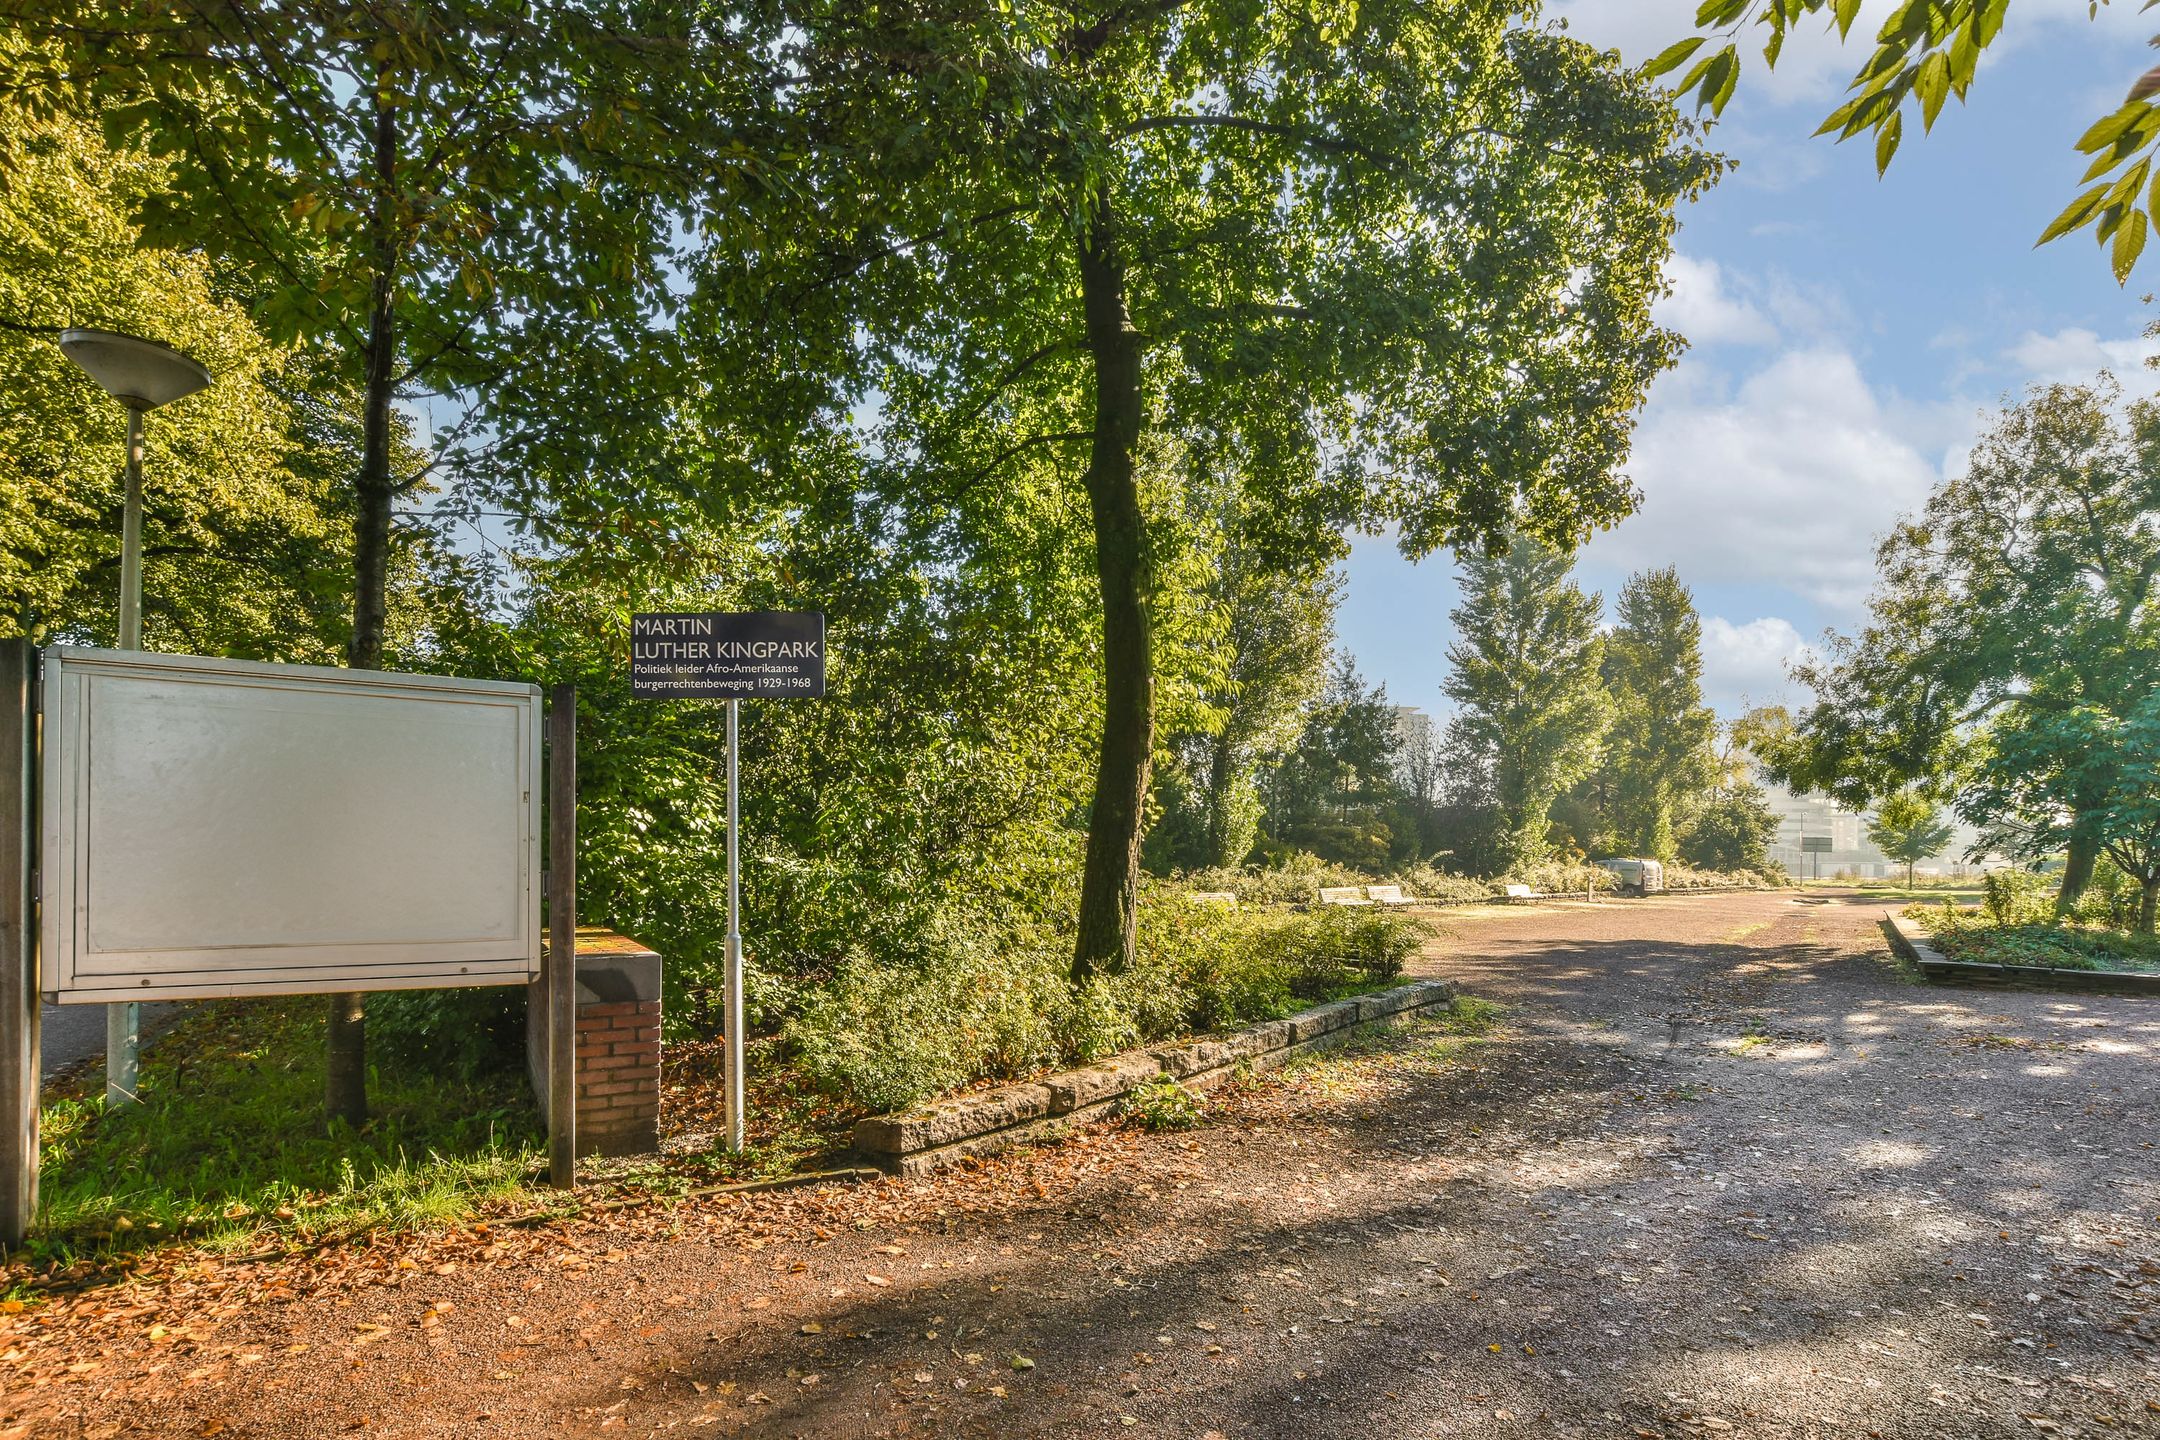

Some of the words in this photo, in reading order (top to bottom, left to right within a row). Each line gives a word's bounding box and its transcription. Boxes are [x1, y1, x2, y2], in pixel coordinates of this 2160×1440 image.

[634, 618, 712, 636] MARTIN
[634, 642, 711, 659] LUTHER
[717, 641, 819, 658] KINGPARK
[634, 663, 672, 674] Politiek
[675, 663, 704, 674] leider
[706, 663, 799, 674] Afro-Amerikaanse
[634, 678, 754, 691] burgerrechtenbeweging
[758, 677, 811, 688] 1929-1968
